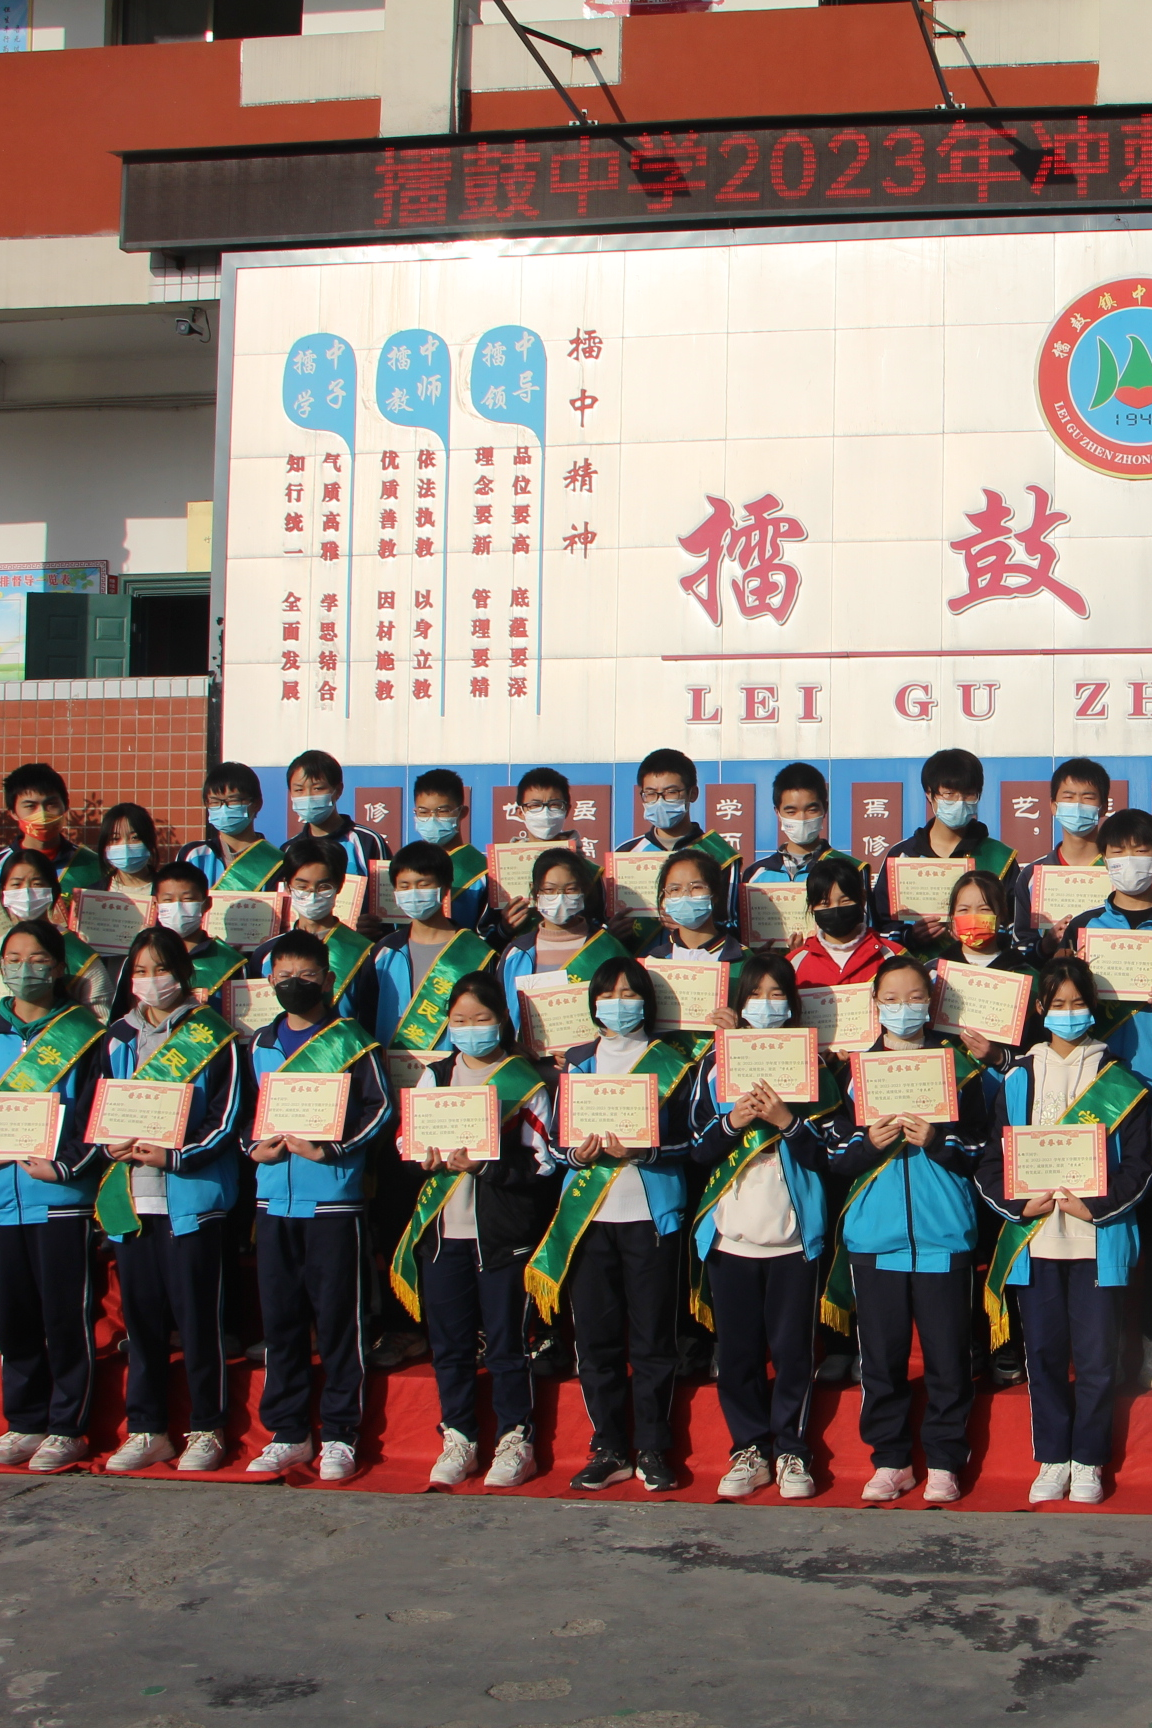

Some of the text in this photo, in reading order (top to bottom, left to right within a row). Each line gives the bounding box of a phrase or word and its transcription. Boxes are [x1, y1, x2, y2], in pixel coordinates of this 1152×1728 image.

[563, 327, 603, 559] 擂中精神
[1053, 401, 1071, 423] LEI
[1066, 421, 1083, 440] GU
[1079, 434, 1114, 461] ZHEN
[280, 454, 306, 701] 知行统一 全面发展
[317, 453, 342, 702] 气质高雅 学思结合
[374, 450, 400, 701] 优质善教 因材施教
[412, 449, 437, 700] 依法执教 以身立教
[470, 446, 494, 698] 理念要新 管理要精
[507, 446, 532, 698] 品位要高 底蕴要深
[688, 685, 819, 722] LEI
[894, 683, 997, 719] GU
[144, 1023, 213, 1080] 学民
[403, 976, 453, 1045] 学民奖
